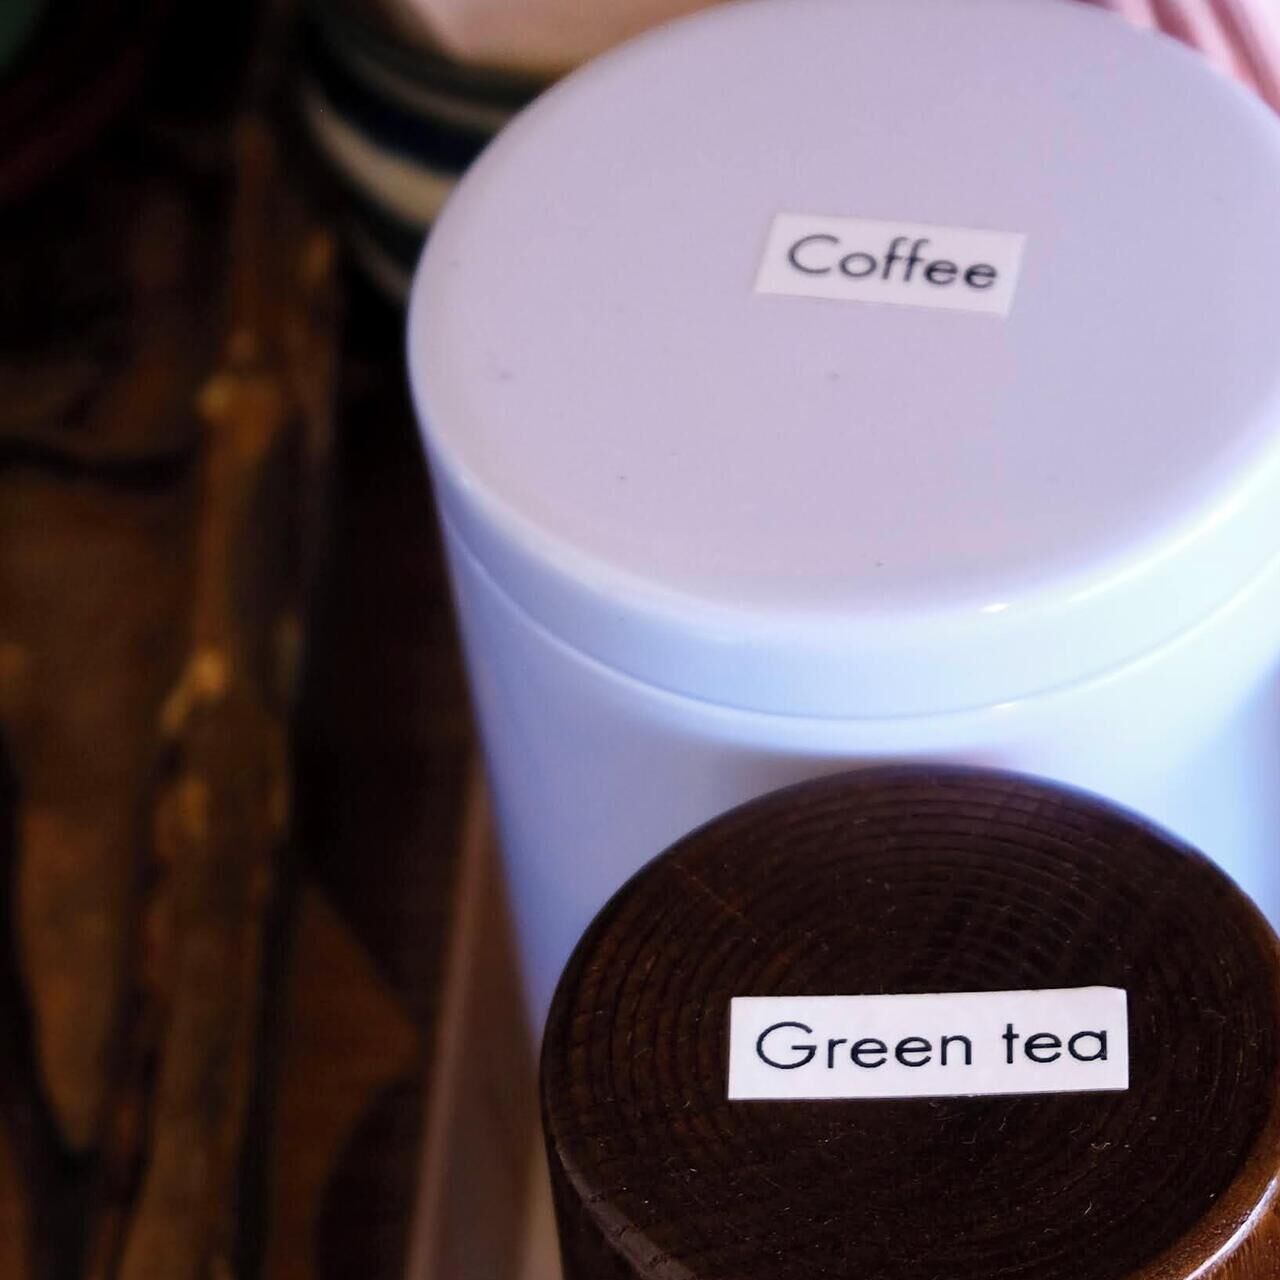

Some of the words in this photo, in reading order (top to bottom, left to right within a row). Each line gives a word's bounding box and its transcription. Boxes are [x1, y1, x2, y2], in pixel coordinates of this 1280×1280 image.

[786, 233, 998, 290] Coffee
[755, 1020, 973, 1070] Green
[1001, 1022, 1109, 1065] tea
